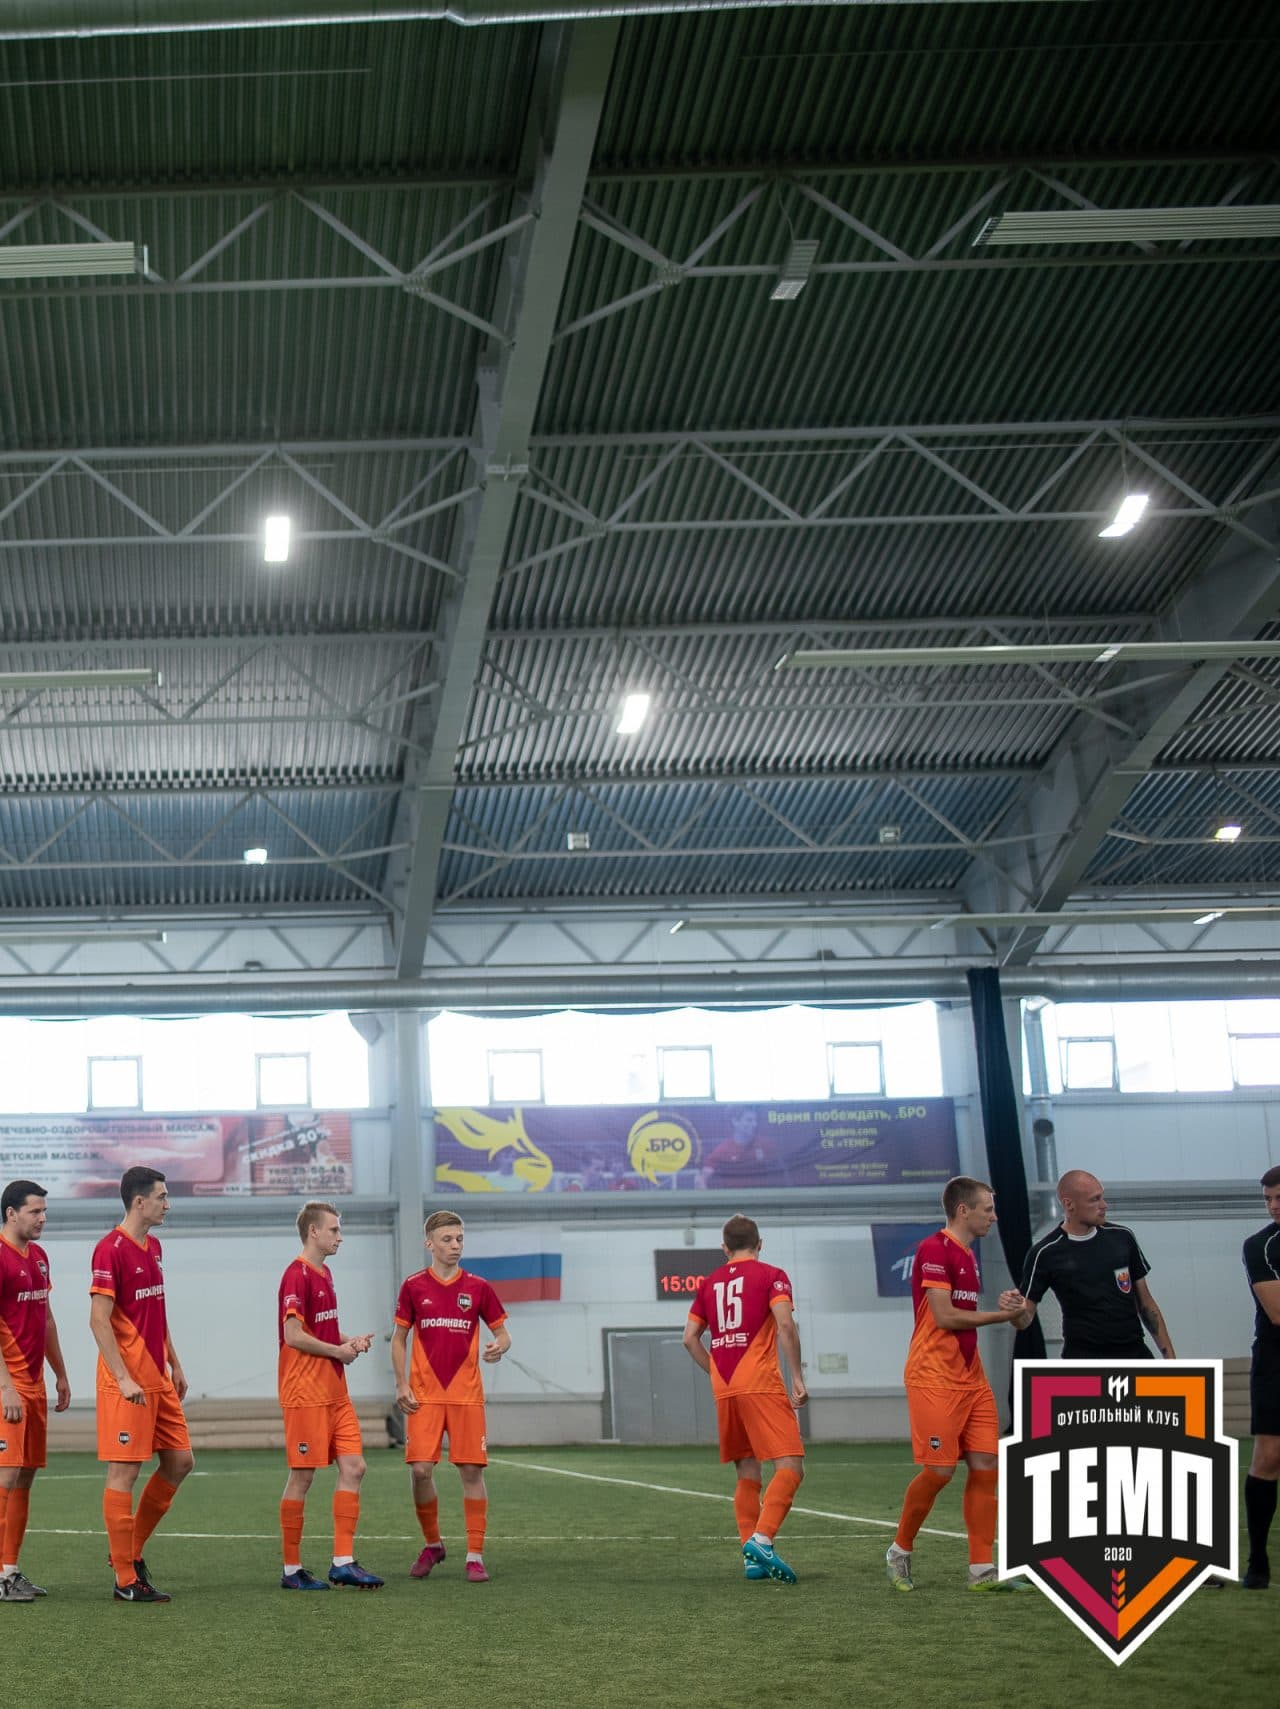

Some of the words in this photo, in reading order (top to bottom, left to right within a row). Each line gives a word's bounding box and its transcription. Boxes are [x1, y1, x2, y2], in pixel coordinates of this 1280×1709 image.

[768, 1110, 811, 1124] Время
[646, 1138, 685, 1152] .БРО
[713, 1276, 745, 1333] 15
[421, 1317, 472, 1330] ПРОДИНВЕСТ
